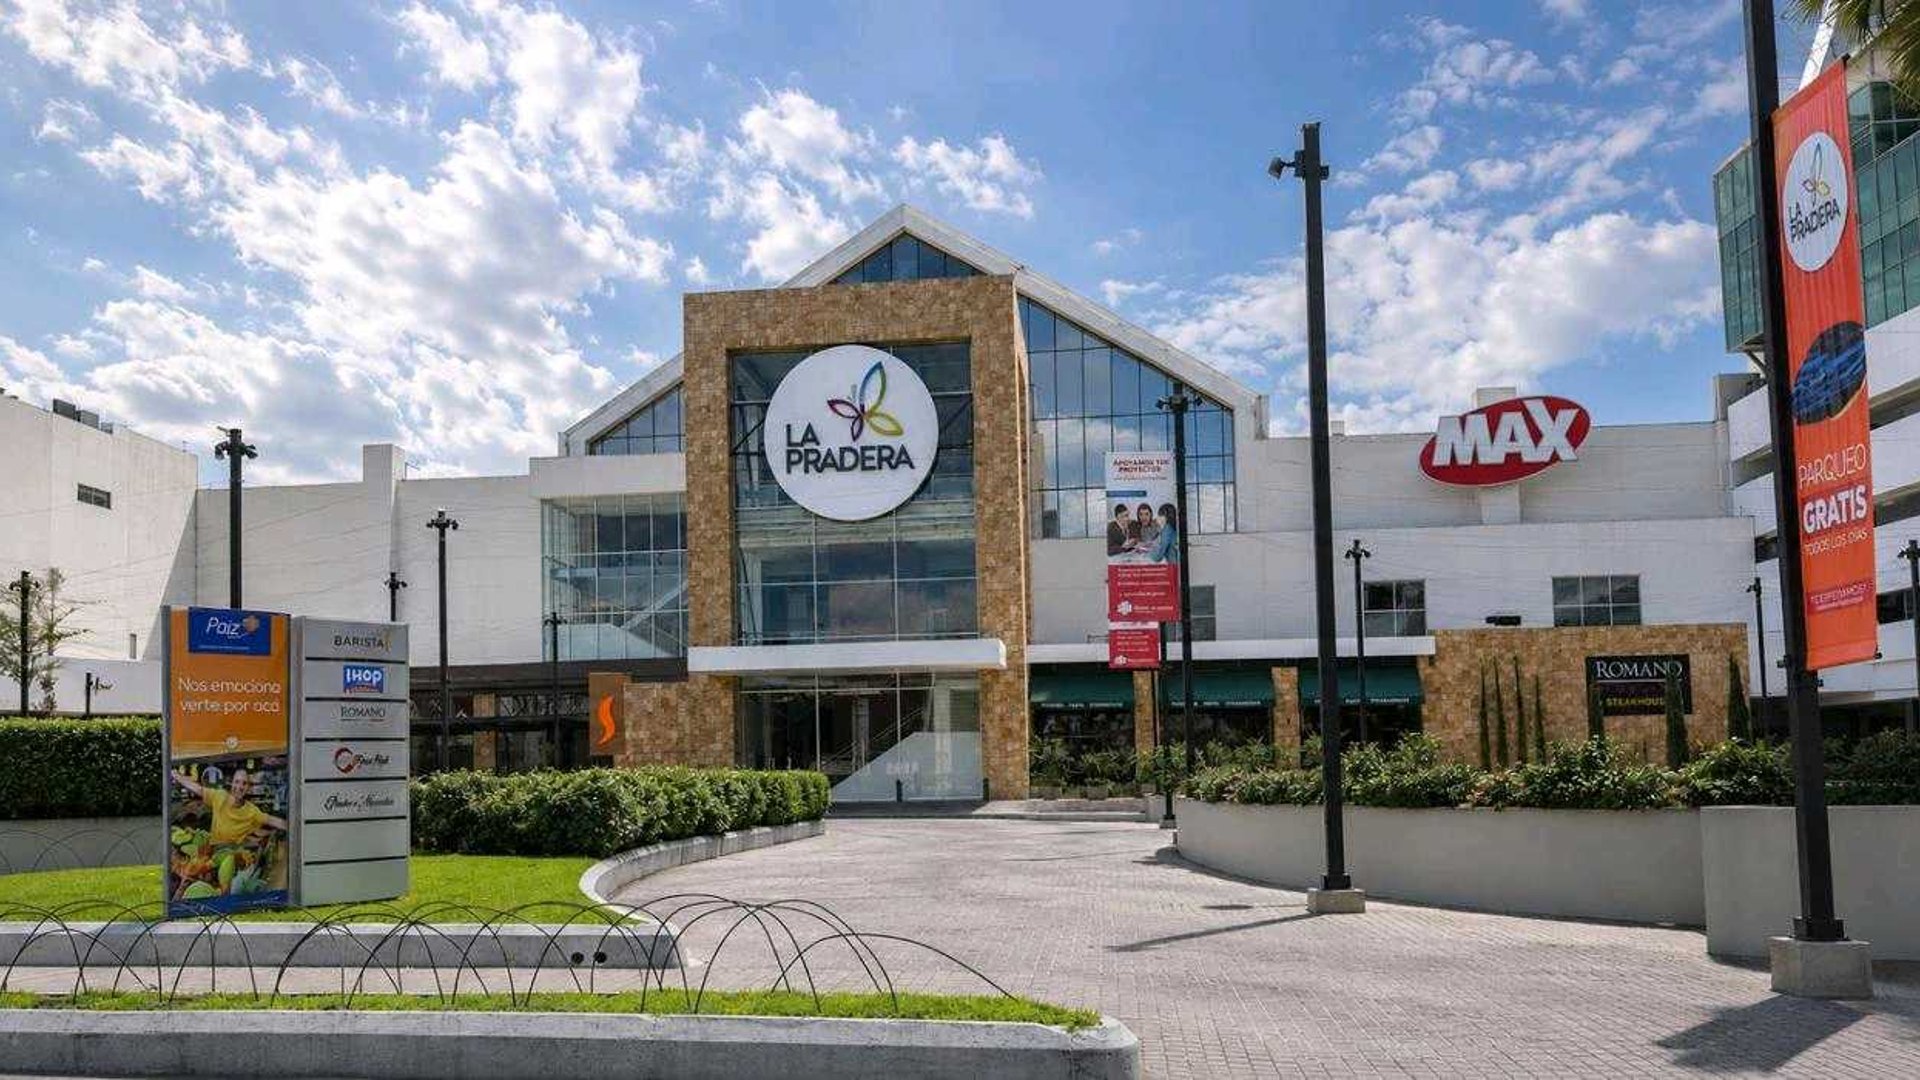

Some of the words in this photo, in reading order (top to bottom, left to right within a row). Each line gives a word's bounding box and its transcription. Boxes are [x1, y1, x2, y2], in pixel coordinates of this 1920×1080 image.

[1788, 201, 1802, 224] LA
[1789, 198, 1842, 243] PRADERA
[785, 422, 820, 448] LA
[1432, 399, 1580, 466] MAX
[785, 443, 916, 475] PRADERA
[1798, 443, 1867, 491] PARQUEO
[1802, 484, 1868, 534] GRATIS
[205, 616, 240, 636] Paiz
[334, 635, 385, 649] BARISTA
[178, 677, 209, 693] Nos
[210, 679, 282, 694] emociona
[223, 701, 251, 715] por
[340, 706, 386, 718] ROMANO
